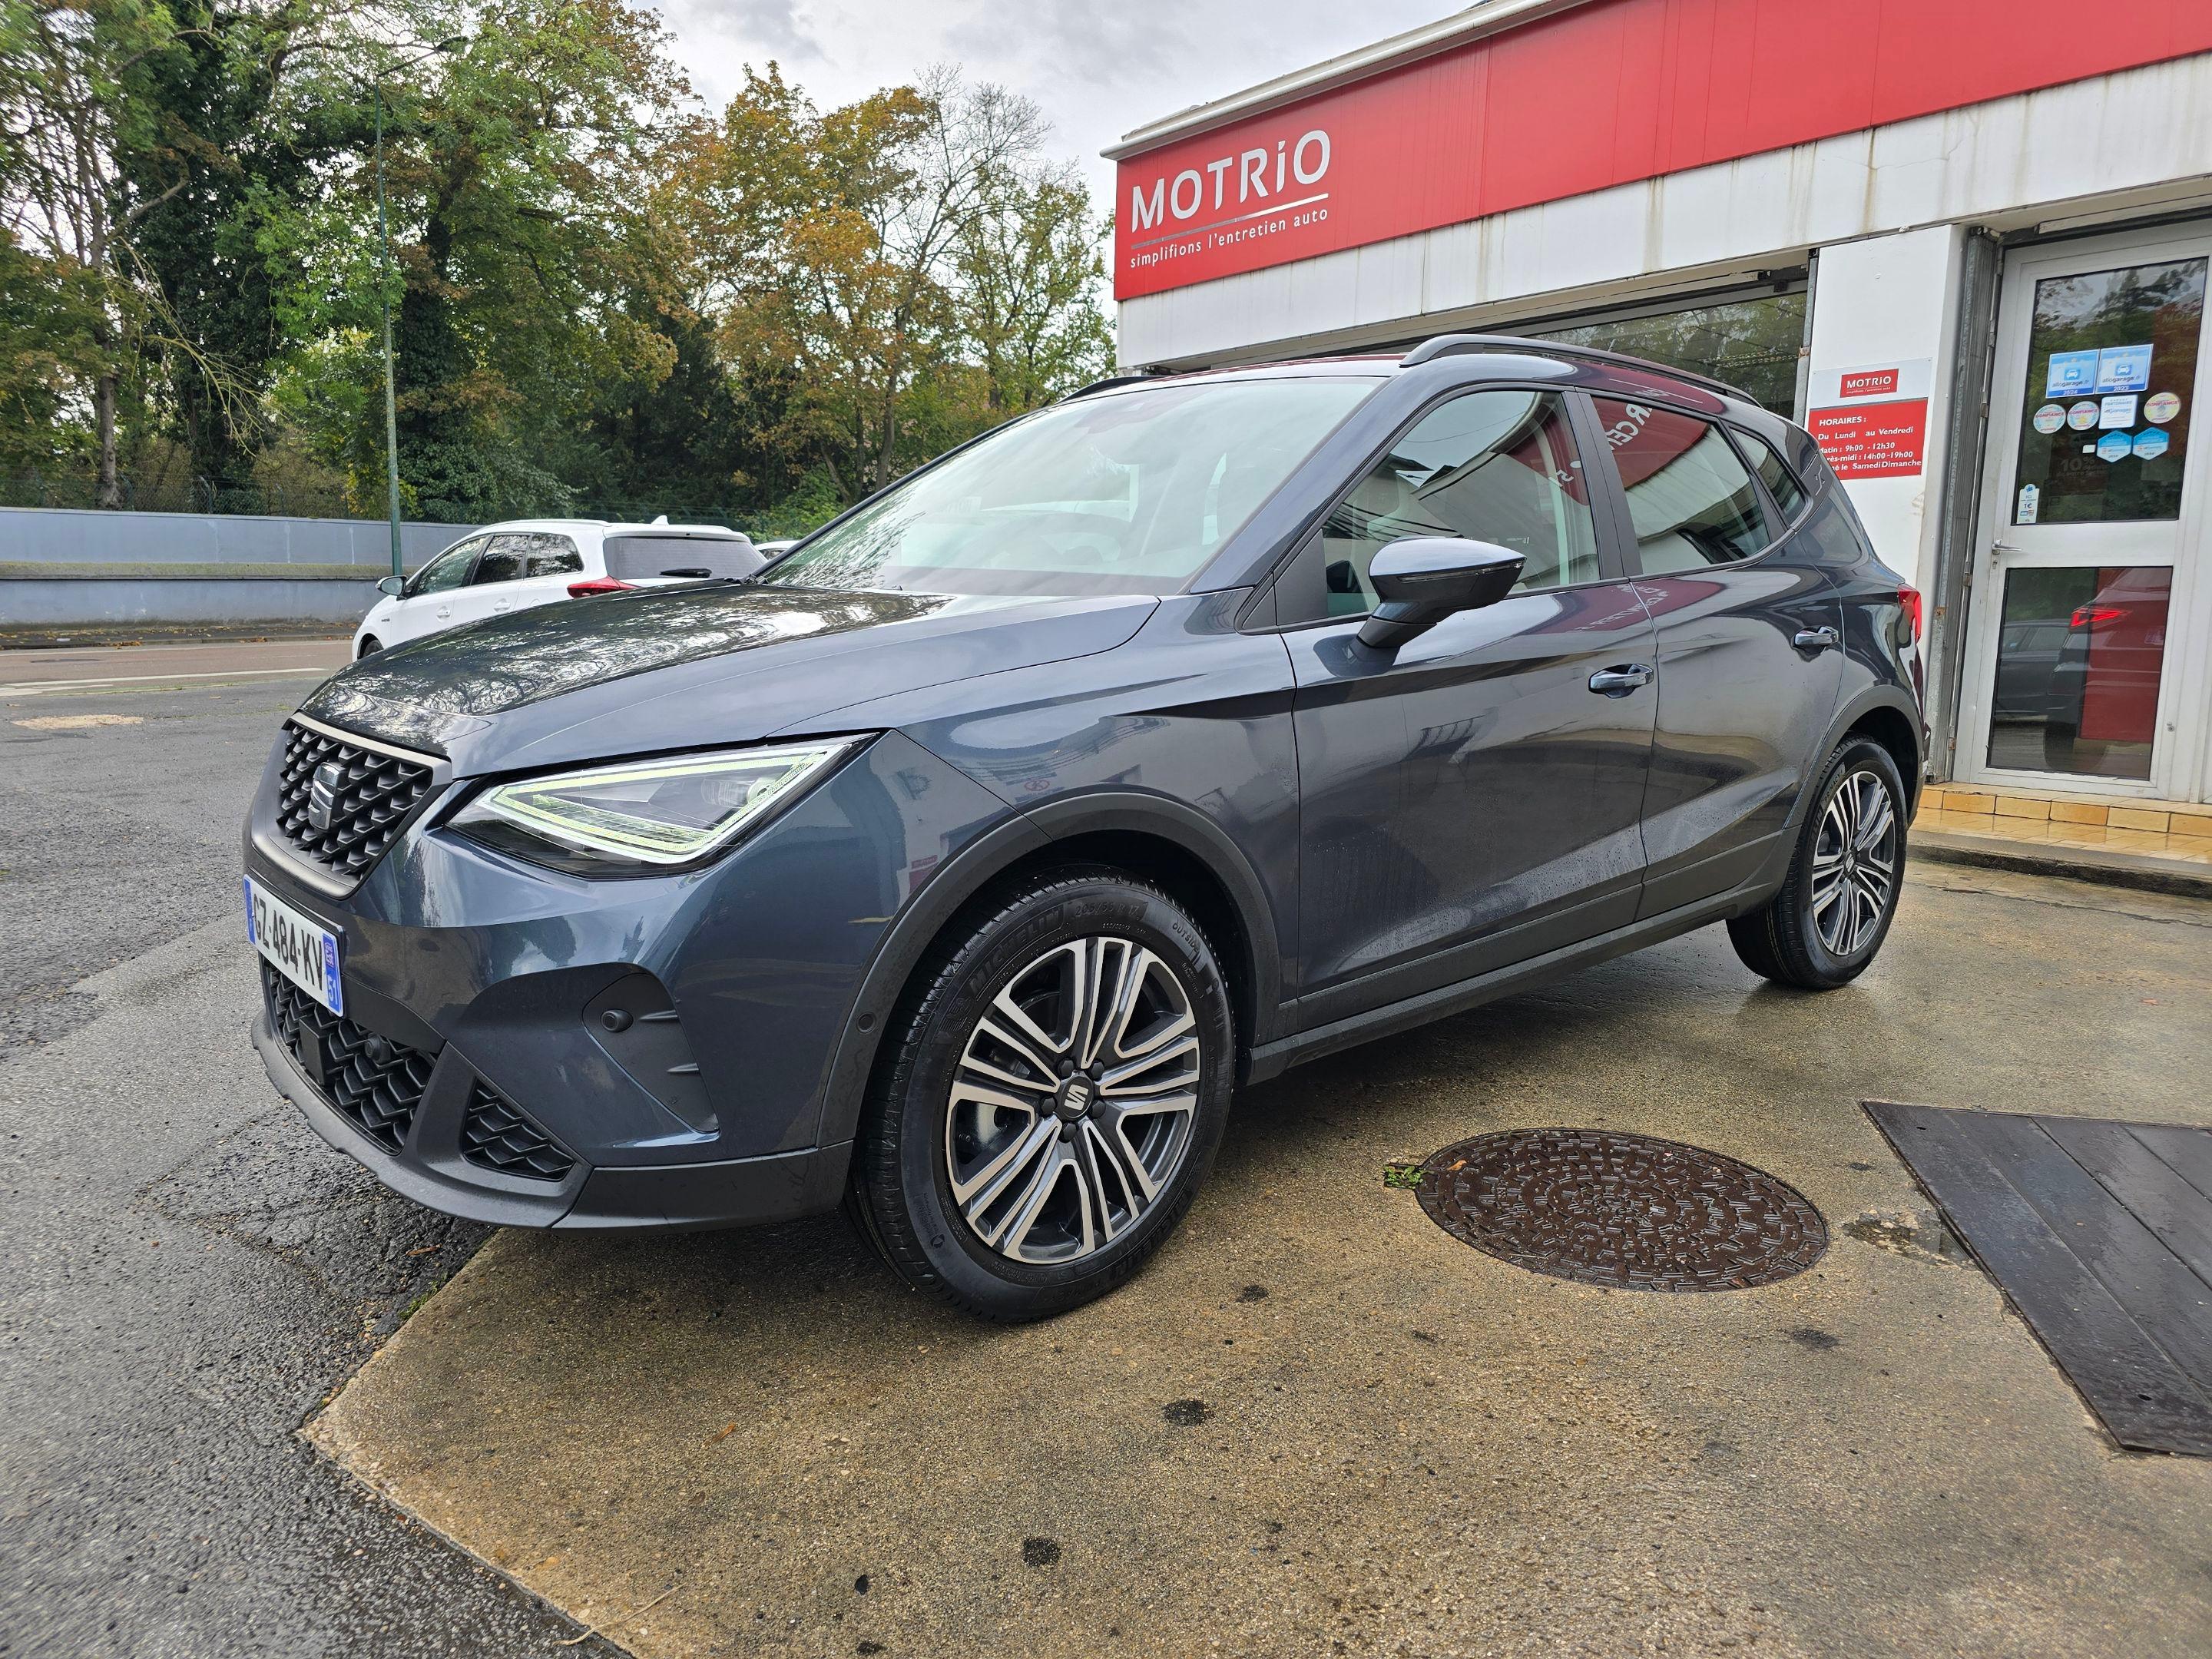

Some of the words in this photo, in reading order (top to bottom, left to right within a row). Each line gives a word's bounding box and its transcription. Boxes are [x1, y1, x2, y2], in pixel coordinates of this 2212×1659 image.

[1131, 240, 1201, 268] simplifions
[1208, 219, 1286, 249] l'entretien
[1293, 208, 1328, 227] auto
[1819, 416, 1862, 426] HORAIRES
[1879, 426, 1913, 435] Vendredi
[1873, 442, 1896, 450] 12h30
[1882, 459, 1922, 468] Dimanche
[1171, 921, 1201, 955] OUTSIDE
